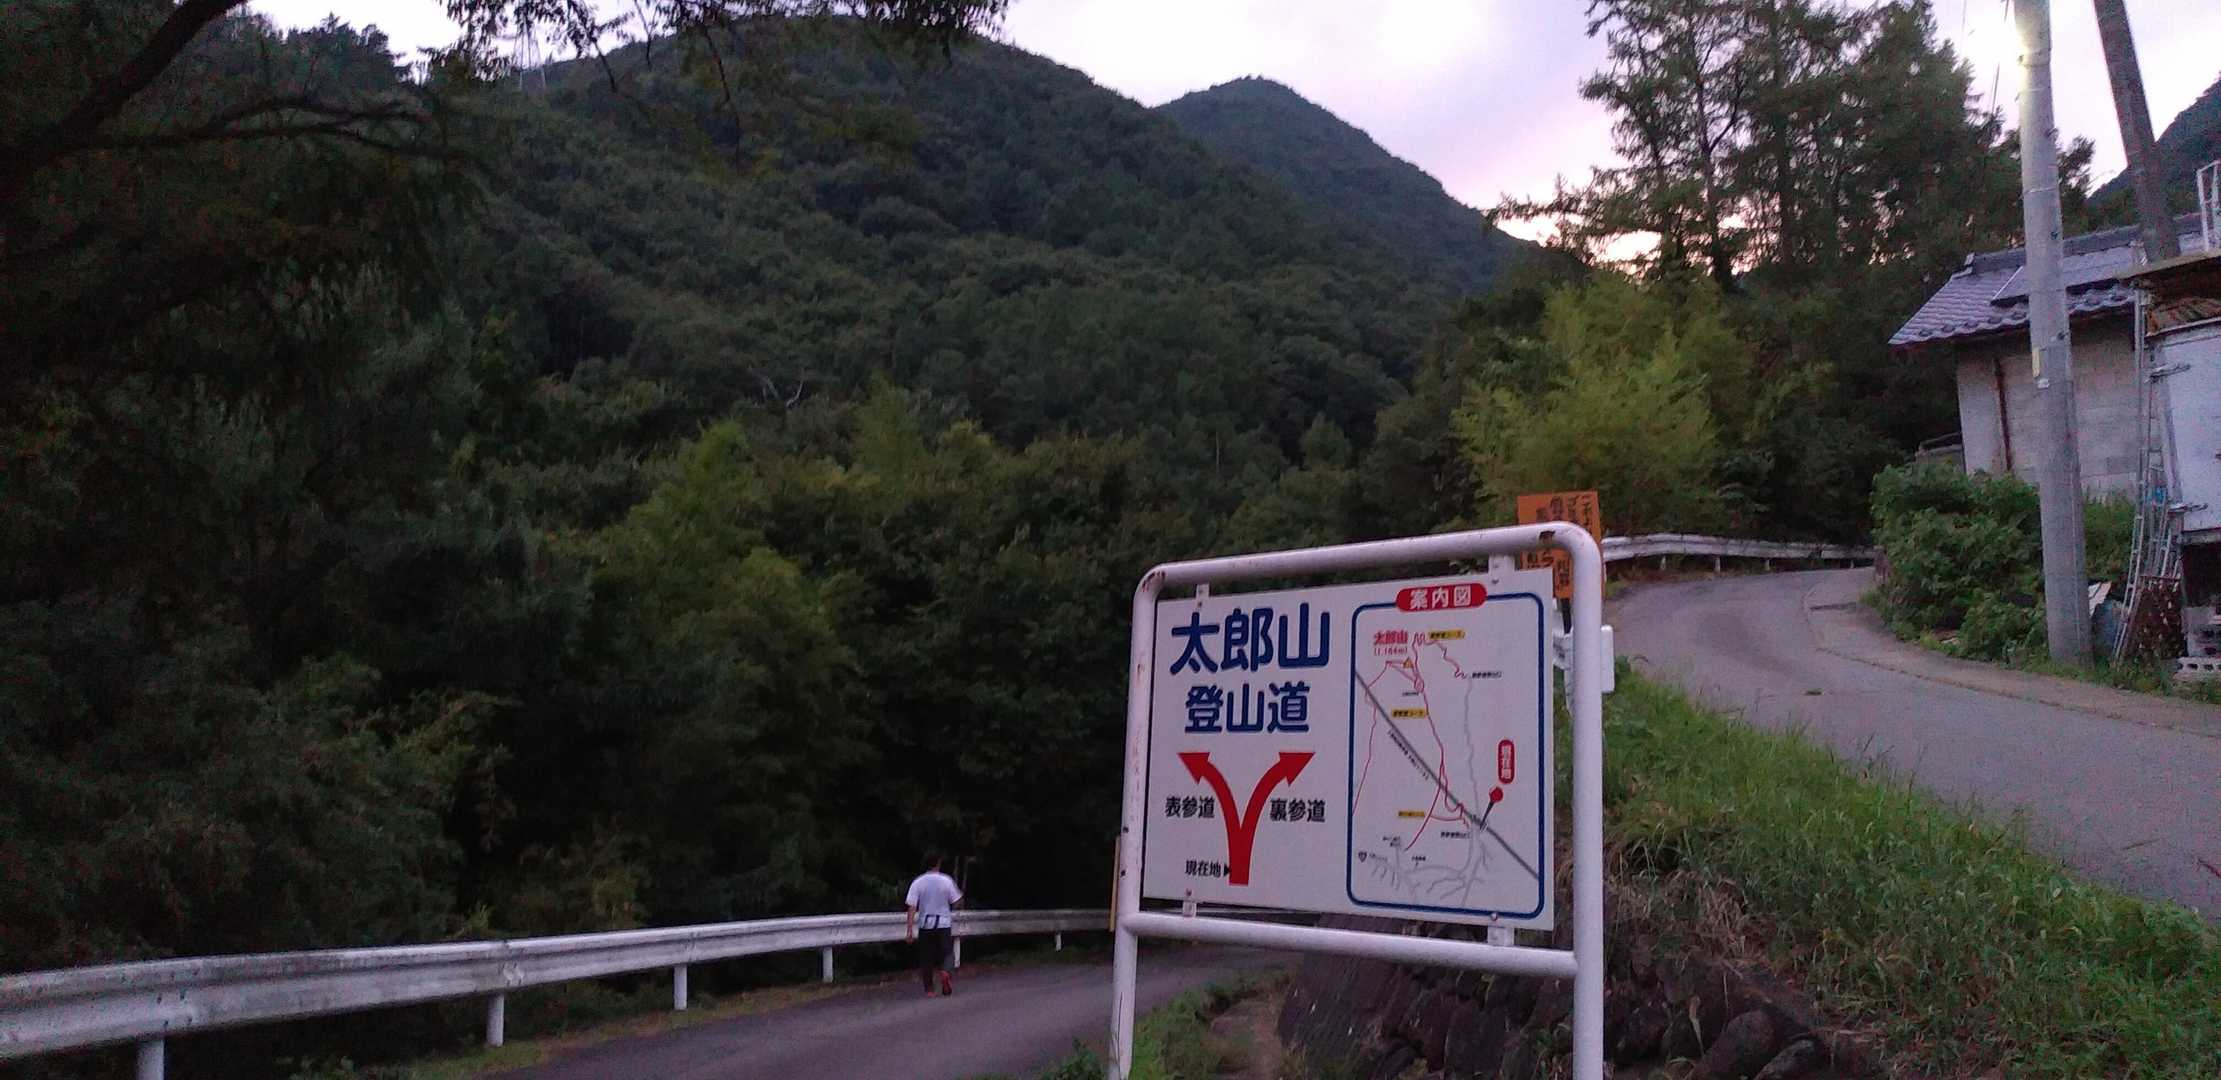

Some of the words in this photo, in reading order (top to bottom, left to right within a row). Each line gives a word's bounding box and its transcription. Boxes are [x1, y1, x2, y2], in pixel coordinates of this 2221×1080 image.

[1410, 586, 1472, 609] 案内図
[1170, 603, 1330, 675] 太郎山
[1184, 681, 1311, 733] 登山道
[1165, 796, 1215, 819] 表参道
[1269, 798, 1326, 822] 裏参道
[1185, 860, 1221, 878] 現在地
